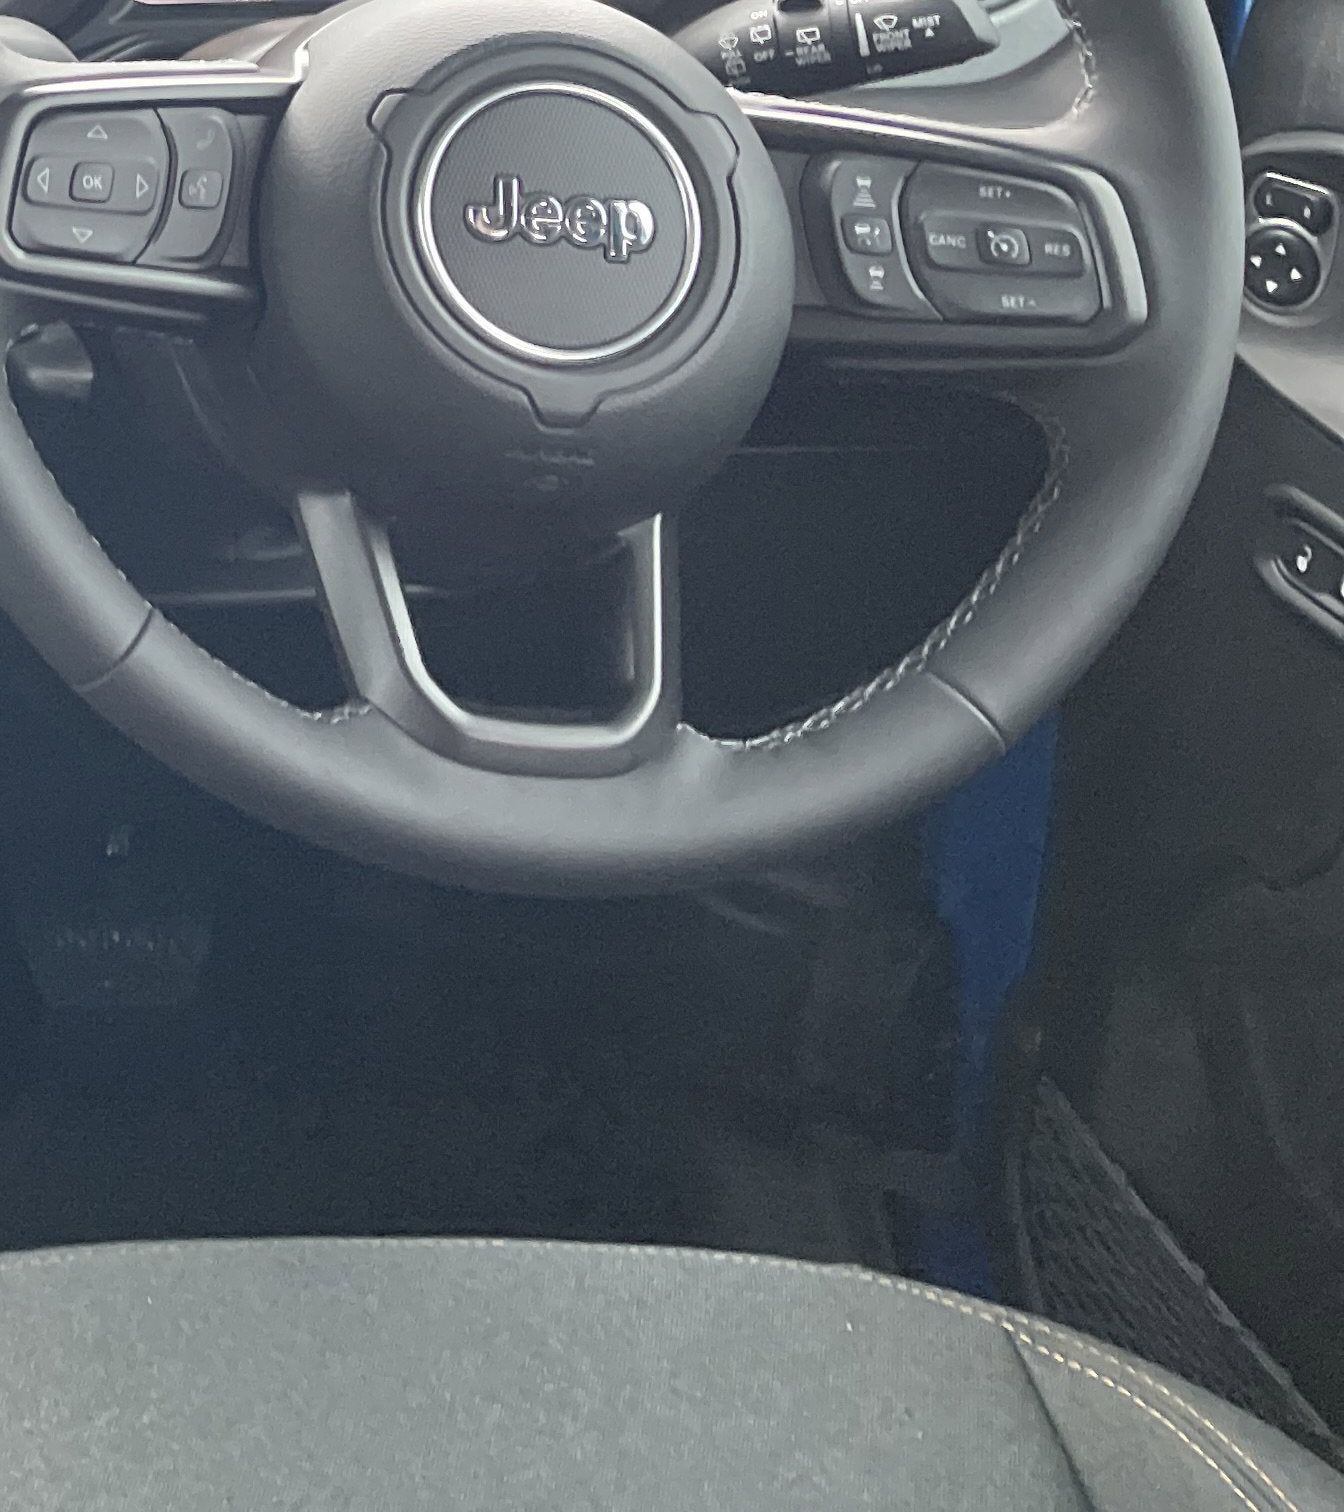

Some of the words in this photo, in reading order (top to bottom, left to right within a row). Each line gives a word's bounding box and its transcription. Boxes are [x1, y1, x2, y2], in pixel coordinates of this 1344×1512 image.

[750, 10, 768, 20] ON
[912, 14, 941, 28] MIST
[82, 175, 102, 190] OK
[464, 173, 656, 263] Jeep
[929, 234, 966, 249] CANC
[1044, 243, 1070, 256] RES
